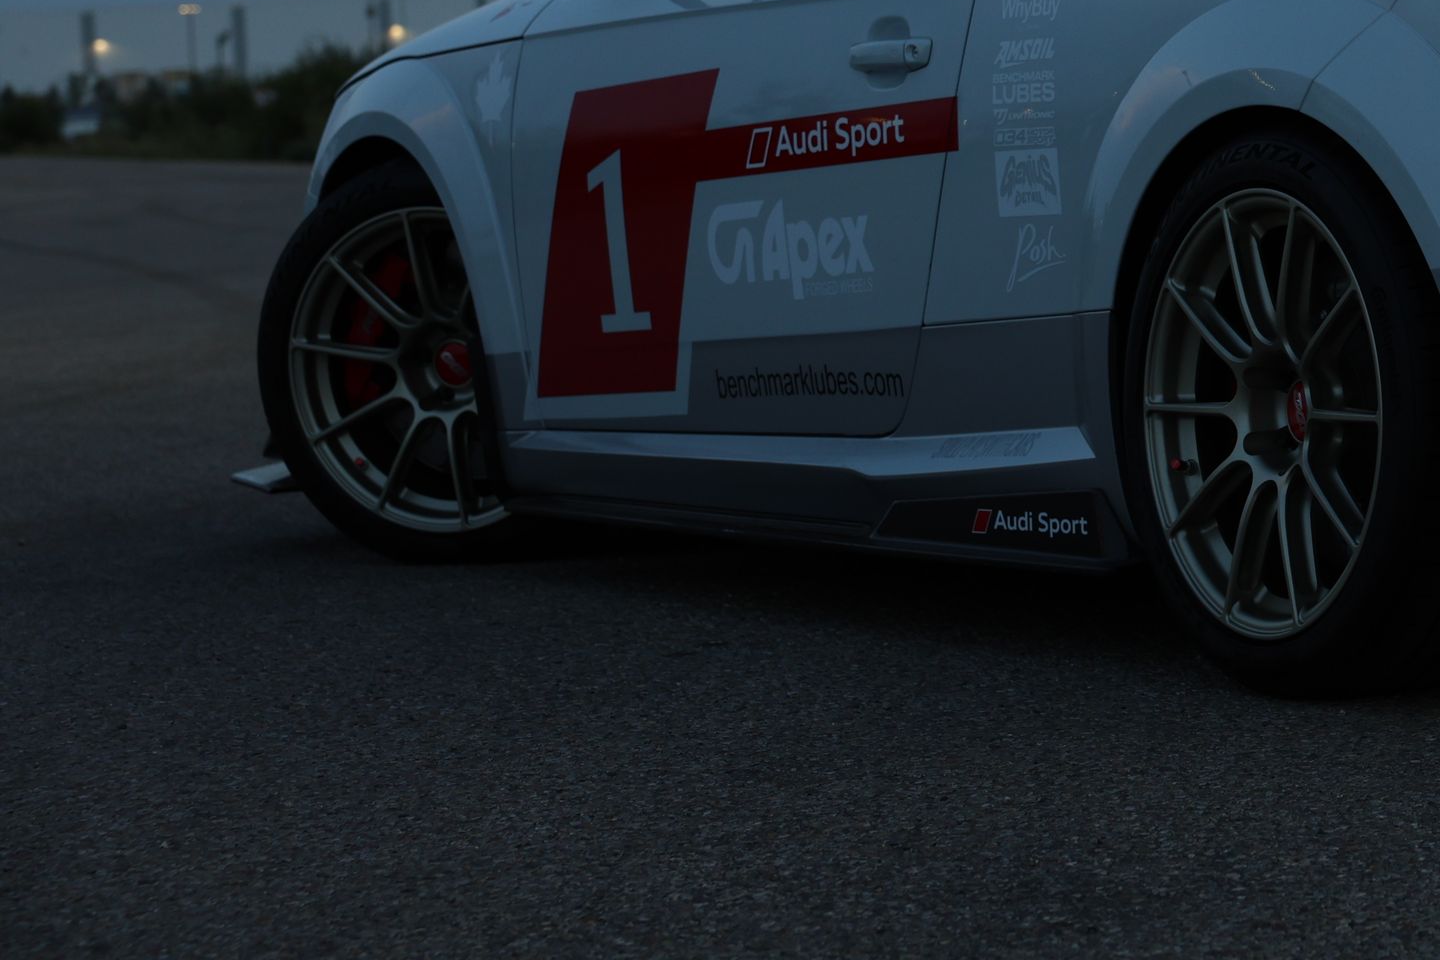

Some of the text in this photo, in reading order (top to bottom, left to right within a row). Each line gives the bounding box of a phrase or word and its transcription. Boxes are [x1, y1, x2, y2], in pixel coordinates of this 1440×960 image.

[993, 37, 1056, 69] AMSOIL
[992, 70, 1056, 84] BENCHMARK
[992, 82, 1056, 105] LUBES
[775, 114, 904, 157] Audi Sport
[585, 147, 653, 334] 1
[762, 197, 876, 301] Apex
[715, 363, 905, 400] benchmarklubes.com
[993, 508, 1089, 538] Audi Sport
